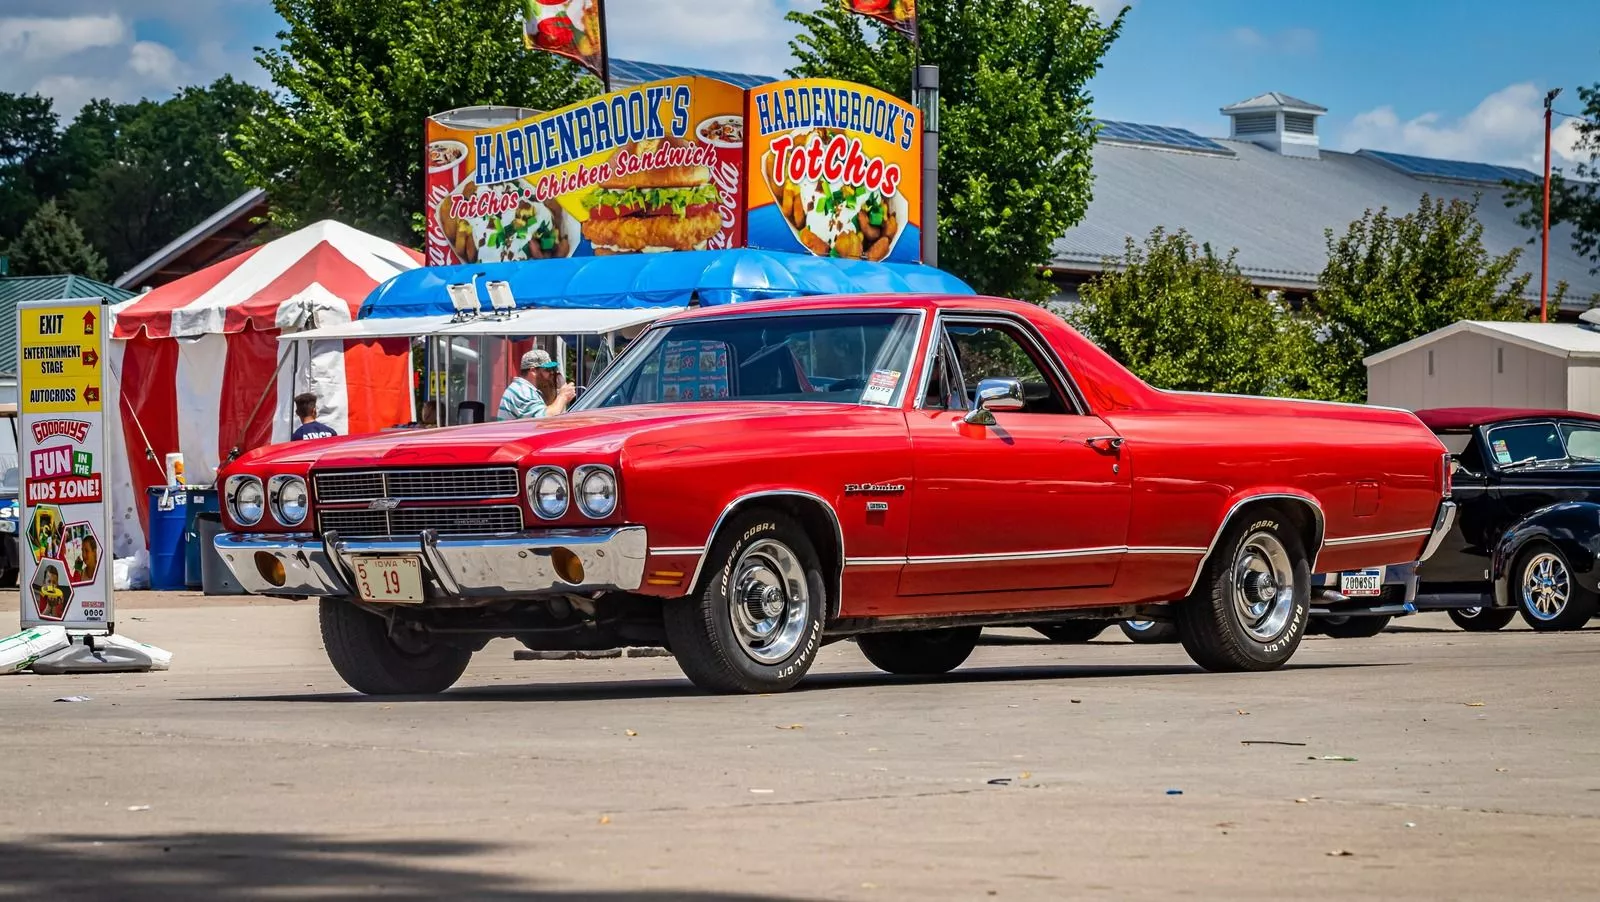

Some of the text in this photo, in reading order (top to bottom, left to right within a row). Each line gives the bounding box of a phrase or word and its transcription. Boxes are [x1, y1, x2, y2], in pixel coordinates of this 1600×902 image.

[756, 87, 915, 151] HARDENBROOK'S
[475, 86, 691, 185] HARDENBROOK'S
[770, 134, 900, 197] TotChos
[450, 140, 718, 219] TotChos Chicken Sandwich
[39, 314, 64, 335] EXIT
[24, 345, 81, 360] ENTERTAINMENT
[41, 361, 64, 374] STAGE
[30, 388, 76, 403] AUTOCROSS
[31, 419, 91, 445] GOODGUYS
[34, 449, 72, 477] FUN
[74, 464, 90, 475] THE
[78, 453, 88, 463] IN
[29, 479, 99, 500] KIDS ZONE!
[1250, 520, 1279, 531] COBRA
[720, 522, 776, 597] COOPER COBRA
[383, 570, 401, 594] 19
[1278, 604, 1303, 647] RADIAL
[794, 619, 820, 667] RADIAL
